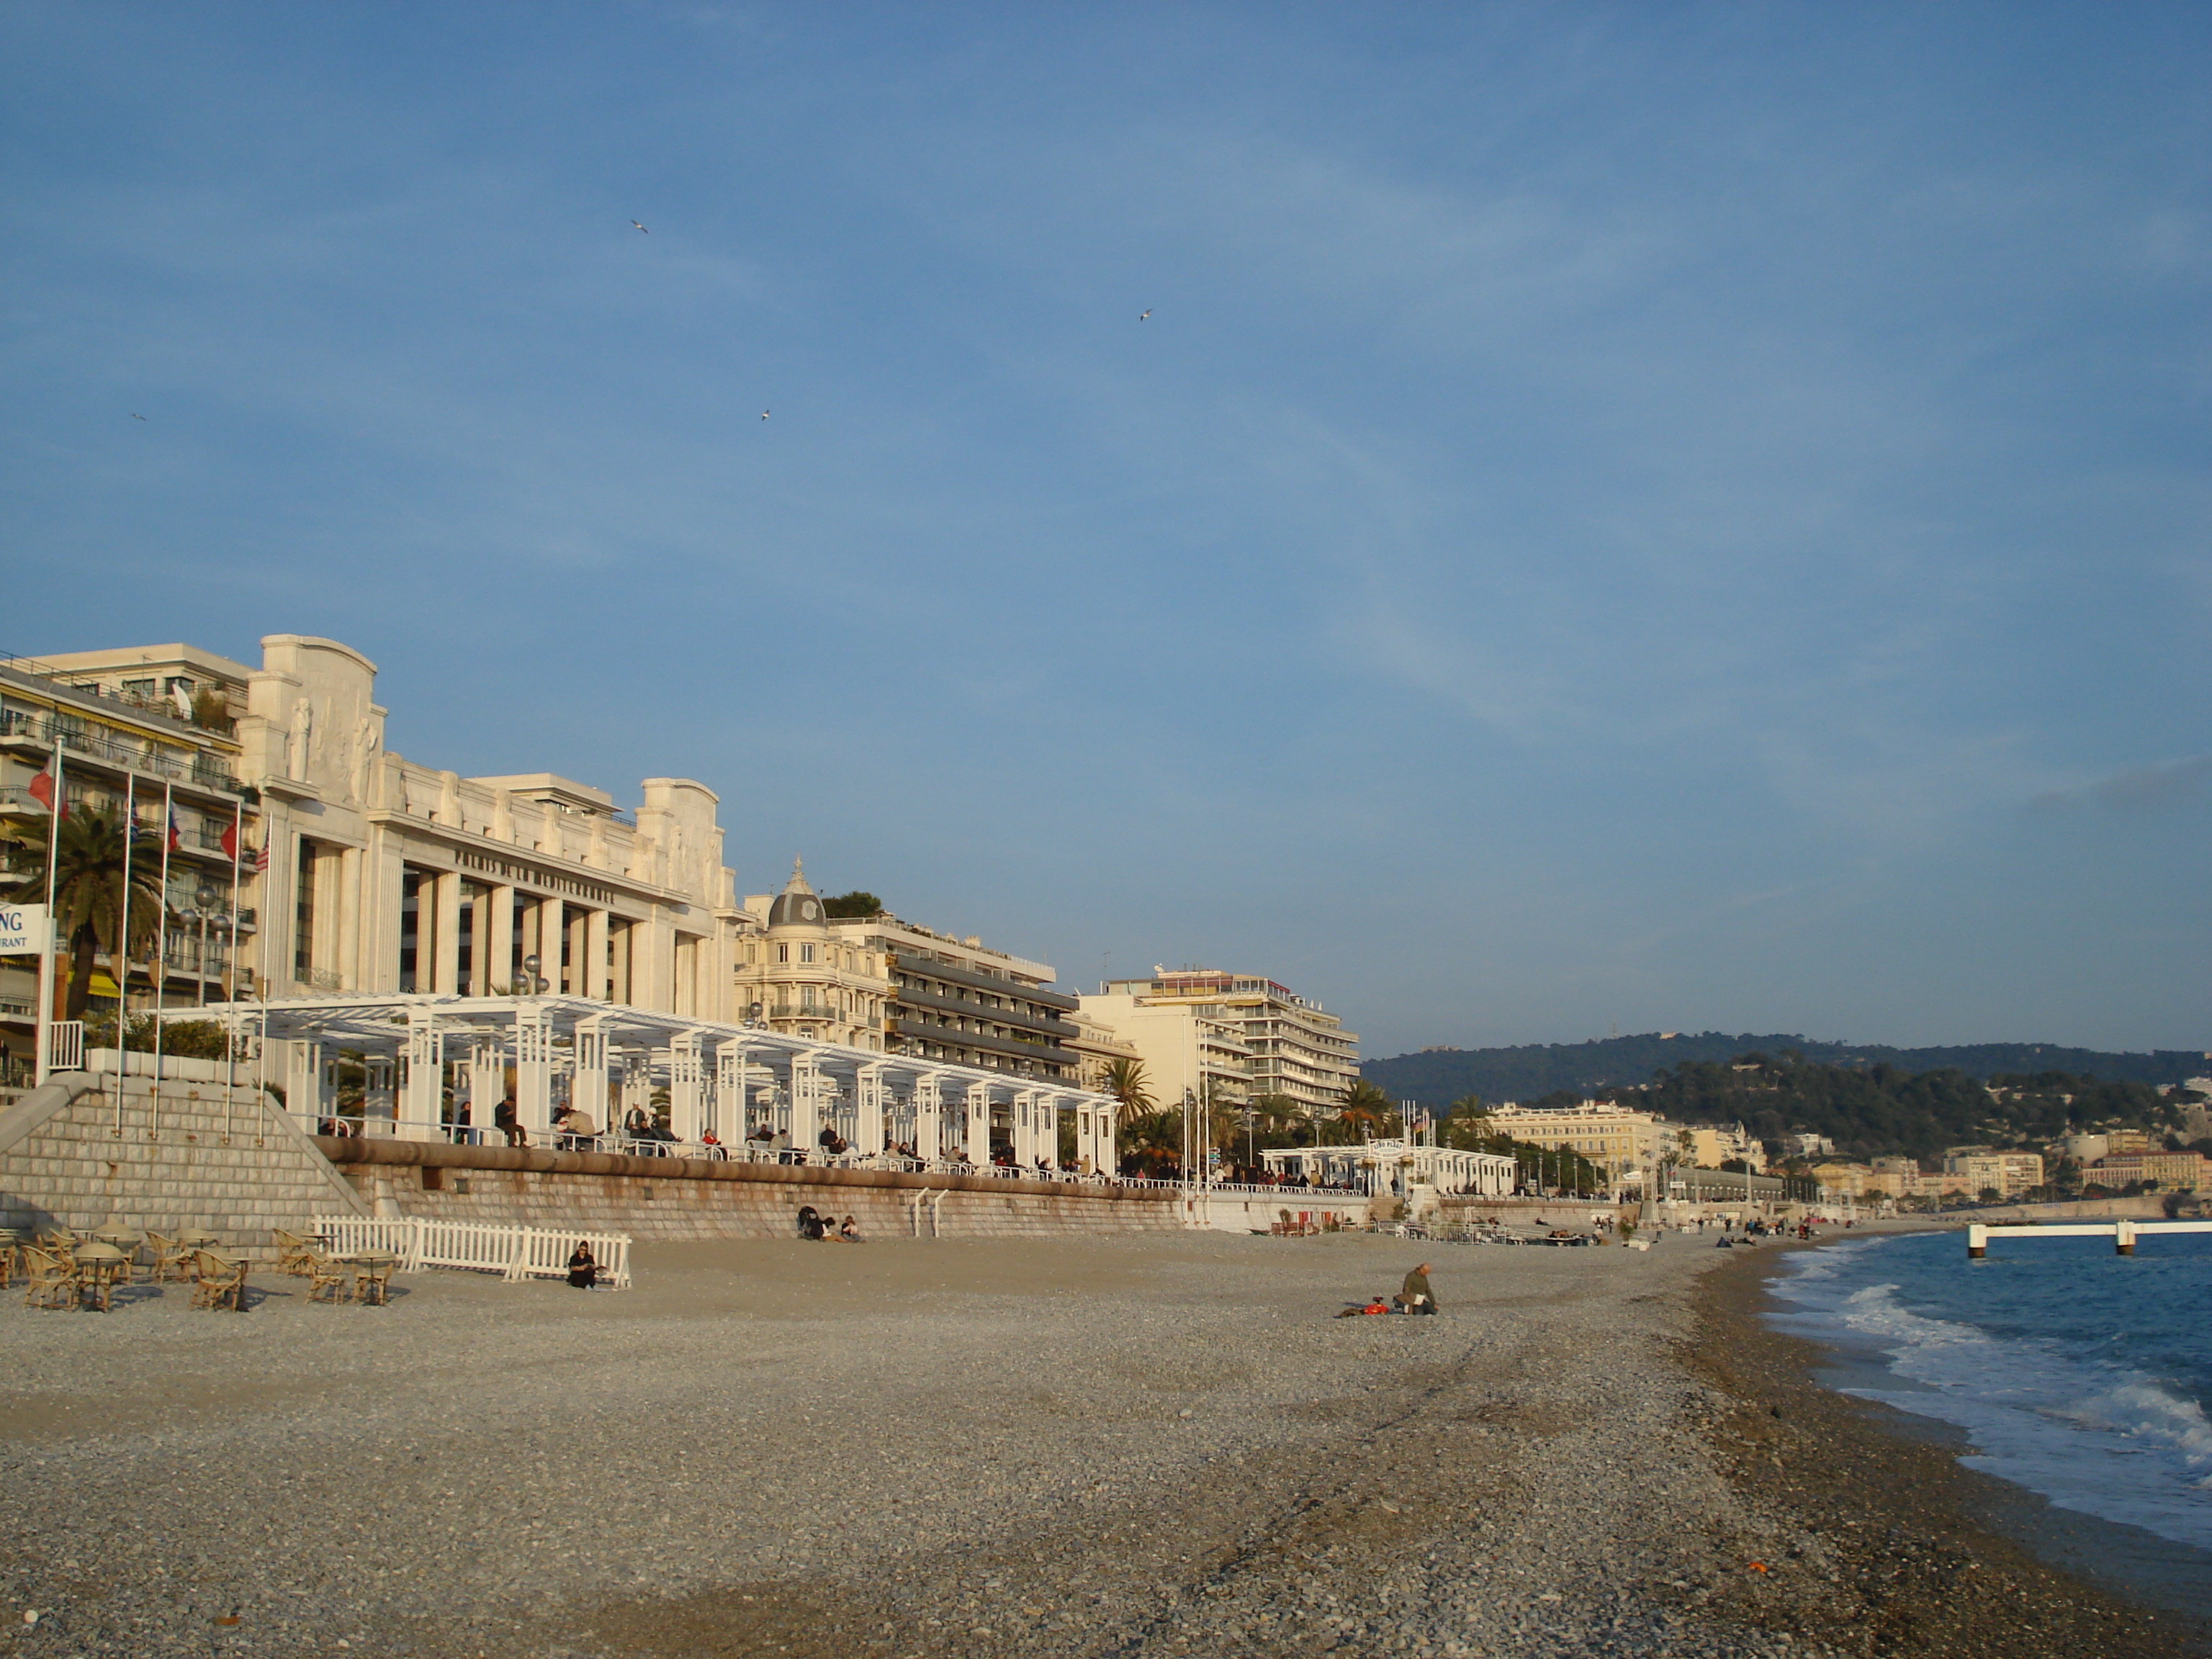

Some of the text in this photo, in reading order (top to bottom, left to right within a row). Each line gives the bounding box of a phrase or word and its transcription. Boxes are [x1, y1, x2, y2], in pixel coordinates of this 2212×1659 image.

[455, 849, 496, 873] PALAIS
[500, 861, 511, 878] DE
[516, 866, 529, 882] LA
